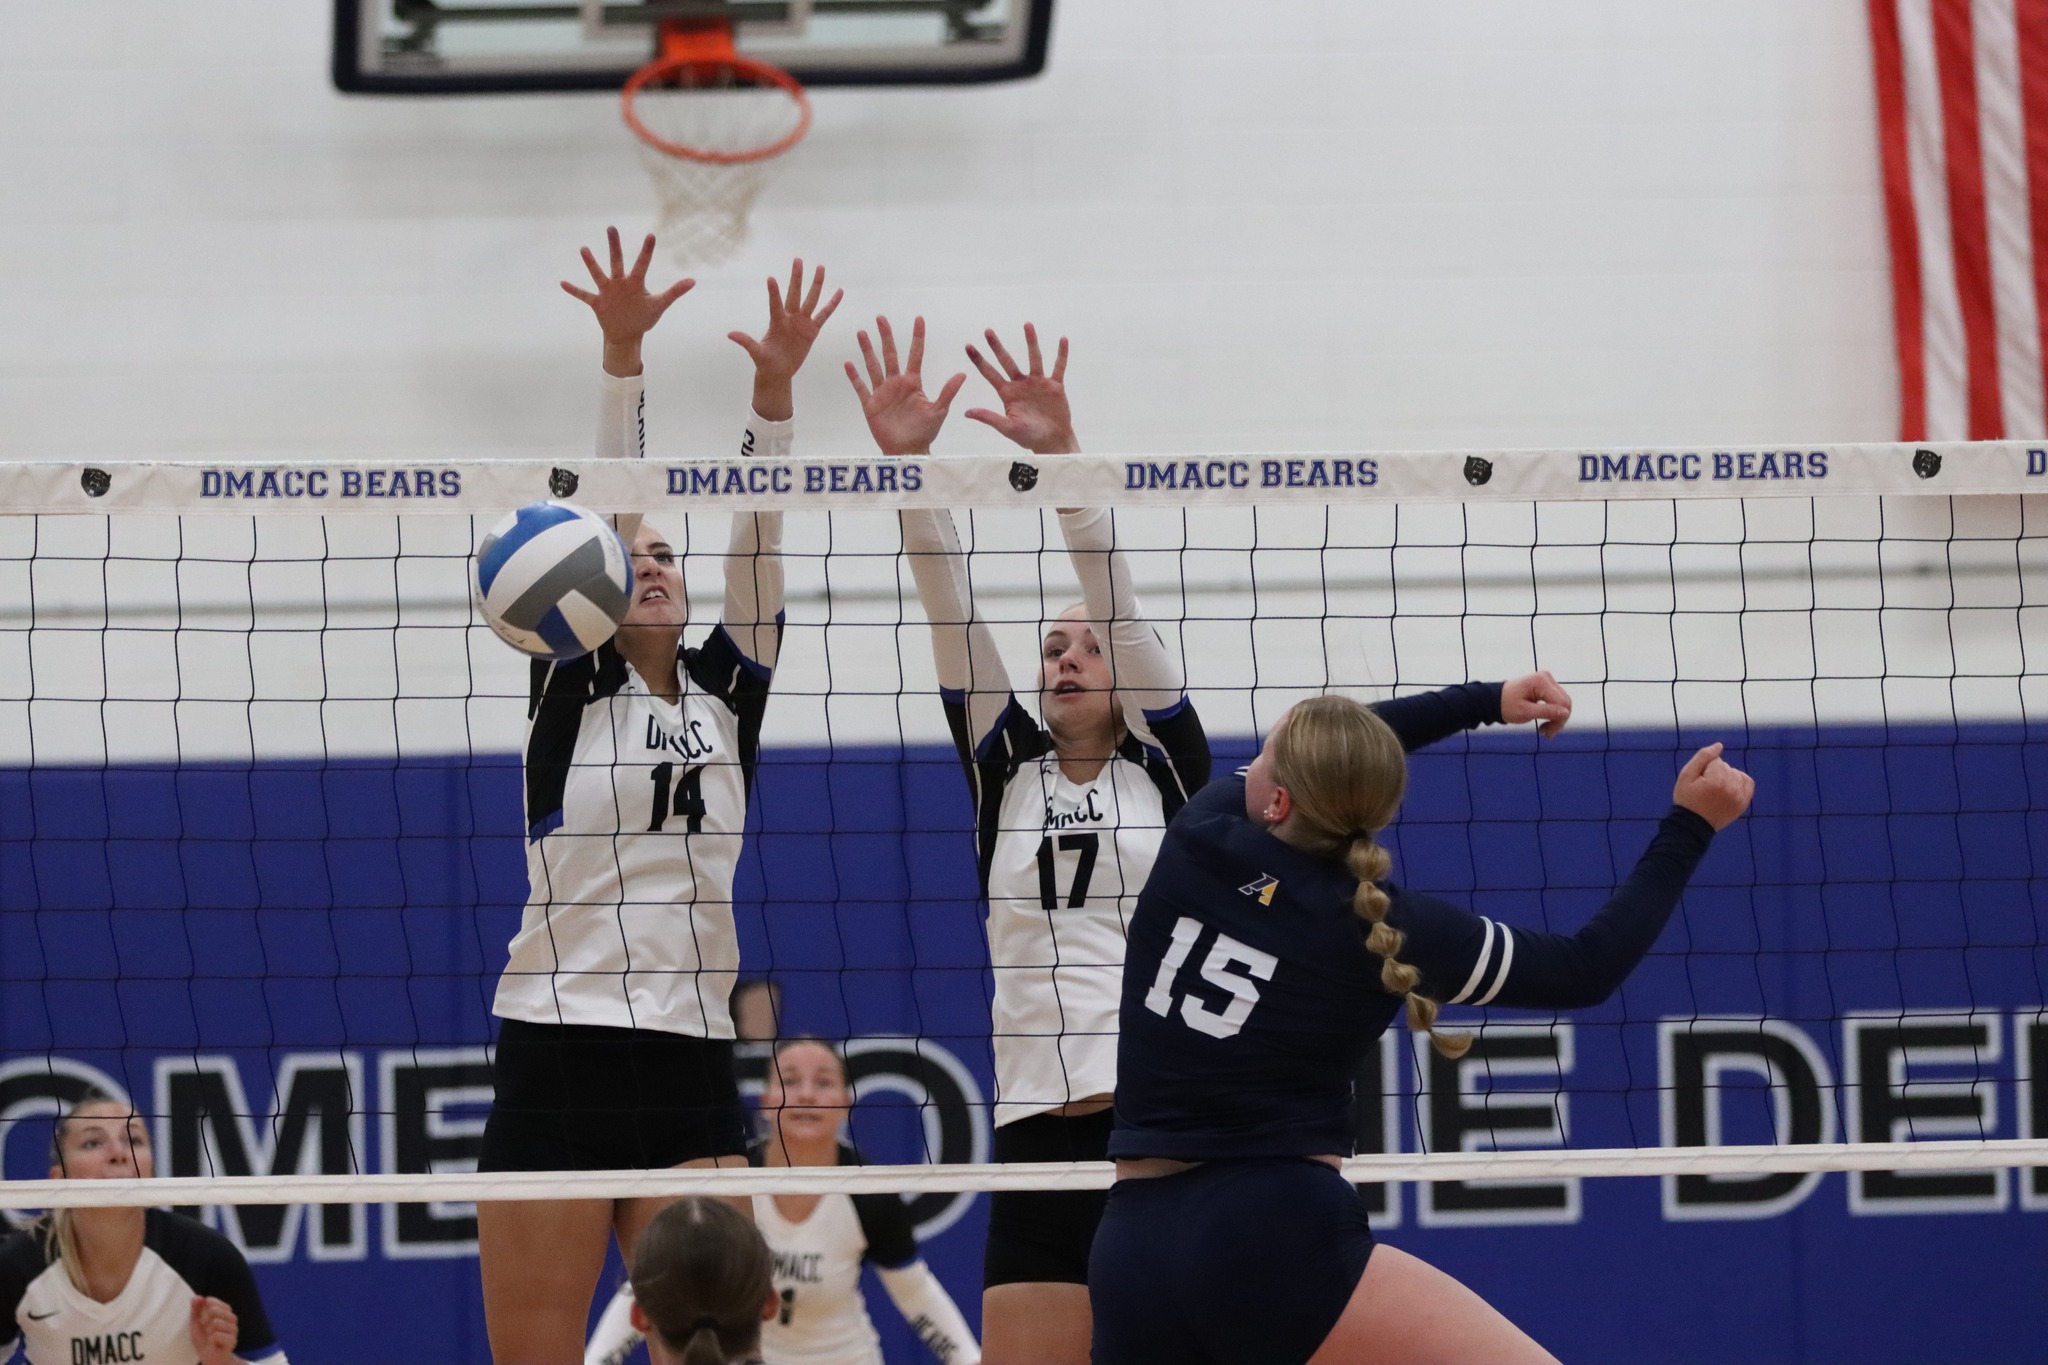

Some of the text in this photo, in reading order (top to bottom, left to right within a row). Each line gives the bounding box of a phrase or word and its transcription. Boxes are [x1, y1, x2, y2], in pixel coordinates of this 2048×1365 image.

[666, 464, 923, 496] DMACC BEARS
[1125, 458, 1378, 490] DMACC BEARS
[1578, 450, 1828, 483] DMACC BEARS
[201, 469, 461, 499] DMACC BEARS
[646, 761, 707, 833] 14
[1036, 832, 1099, 911] 17
[1144, 916, 1279, 1040] 15
[71, 1330, 145, 1365] DMACC
